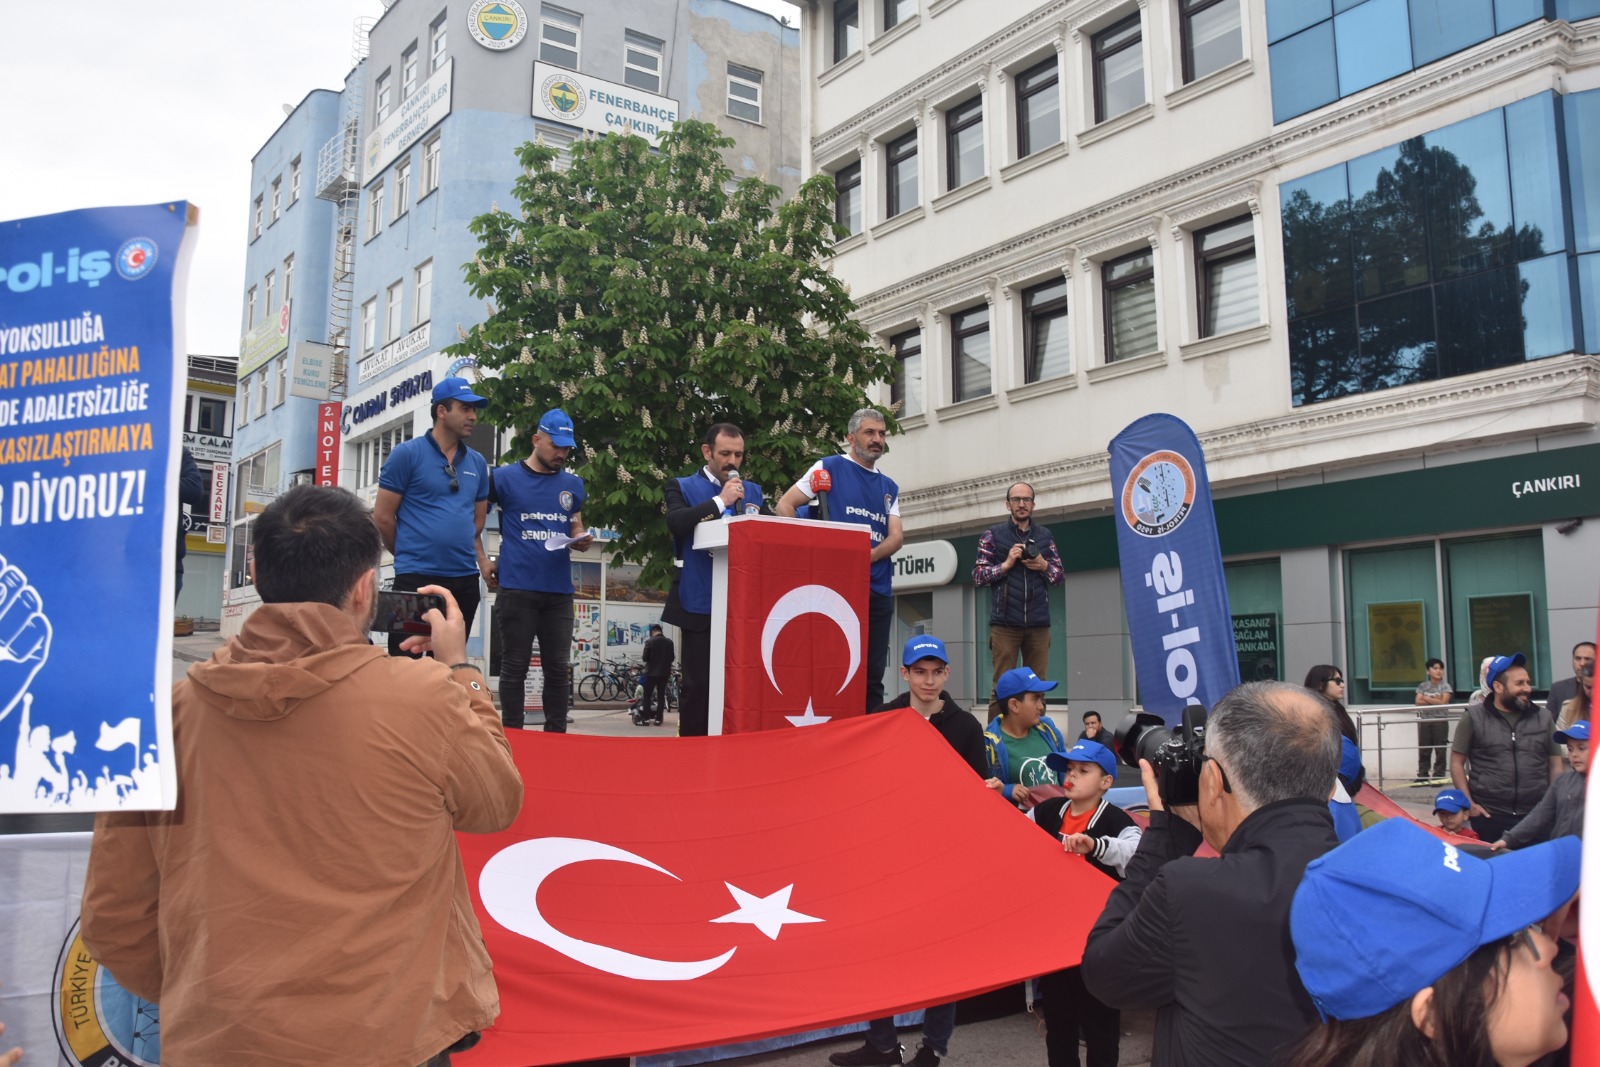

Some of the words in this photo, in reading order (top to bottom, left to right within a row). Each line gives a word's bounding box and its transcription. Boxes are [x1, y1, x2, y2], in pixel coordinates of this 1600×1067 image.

[383, 83, 447, 147] FENERBAHÇELİLER
[401, 83, 429, 117] ÇANKIRI
[589, 89, 675, 122] FENERBAHÇE
[399, 114, 429, 151] DERNEĞİ
[0, 311, 105, 355] YOKSULLUĞA
[397, 327, 427, 354] AVUKAT
[21, 345, 140, 388] PAHALILIĞINA
[302, 357, 323, 367] ELBİSE
[363, 348, 389, 374] AVUKAT
[294, 376, 327, 389] TEMİZLEME
[22, 379, 149, 425] ADALETSİZLİĞE
[324, 406, 334, 417] 2.
[11, 469, 146, 526] DİYORUZ!
[214, 473, 224, 519] ECZANE
[1512, 474, 1580, 498] ÇANKIRI
[520, 512, 568, 523] petrol-iş
[1233, 618, 1270, 629] KASANIZ
[1234, 629, 1268, 640] SAĞLAM
[69, 952, 92, 1030] TÜRKİYE
